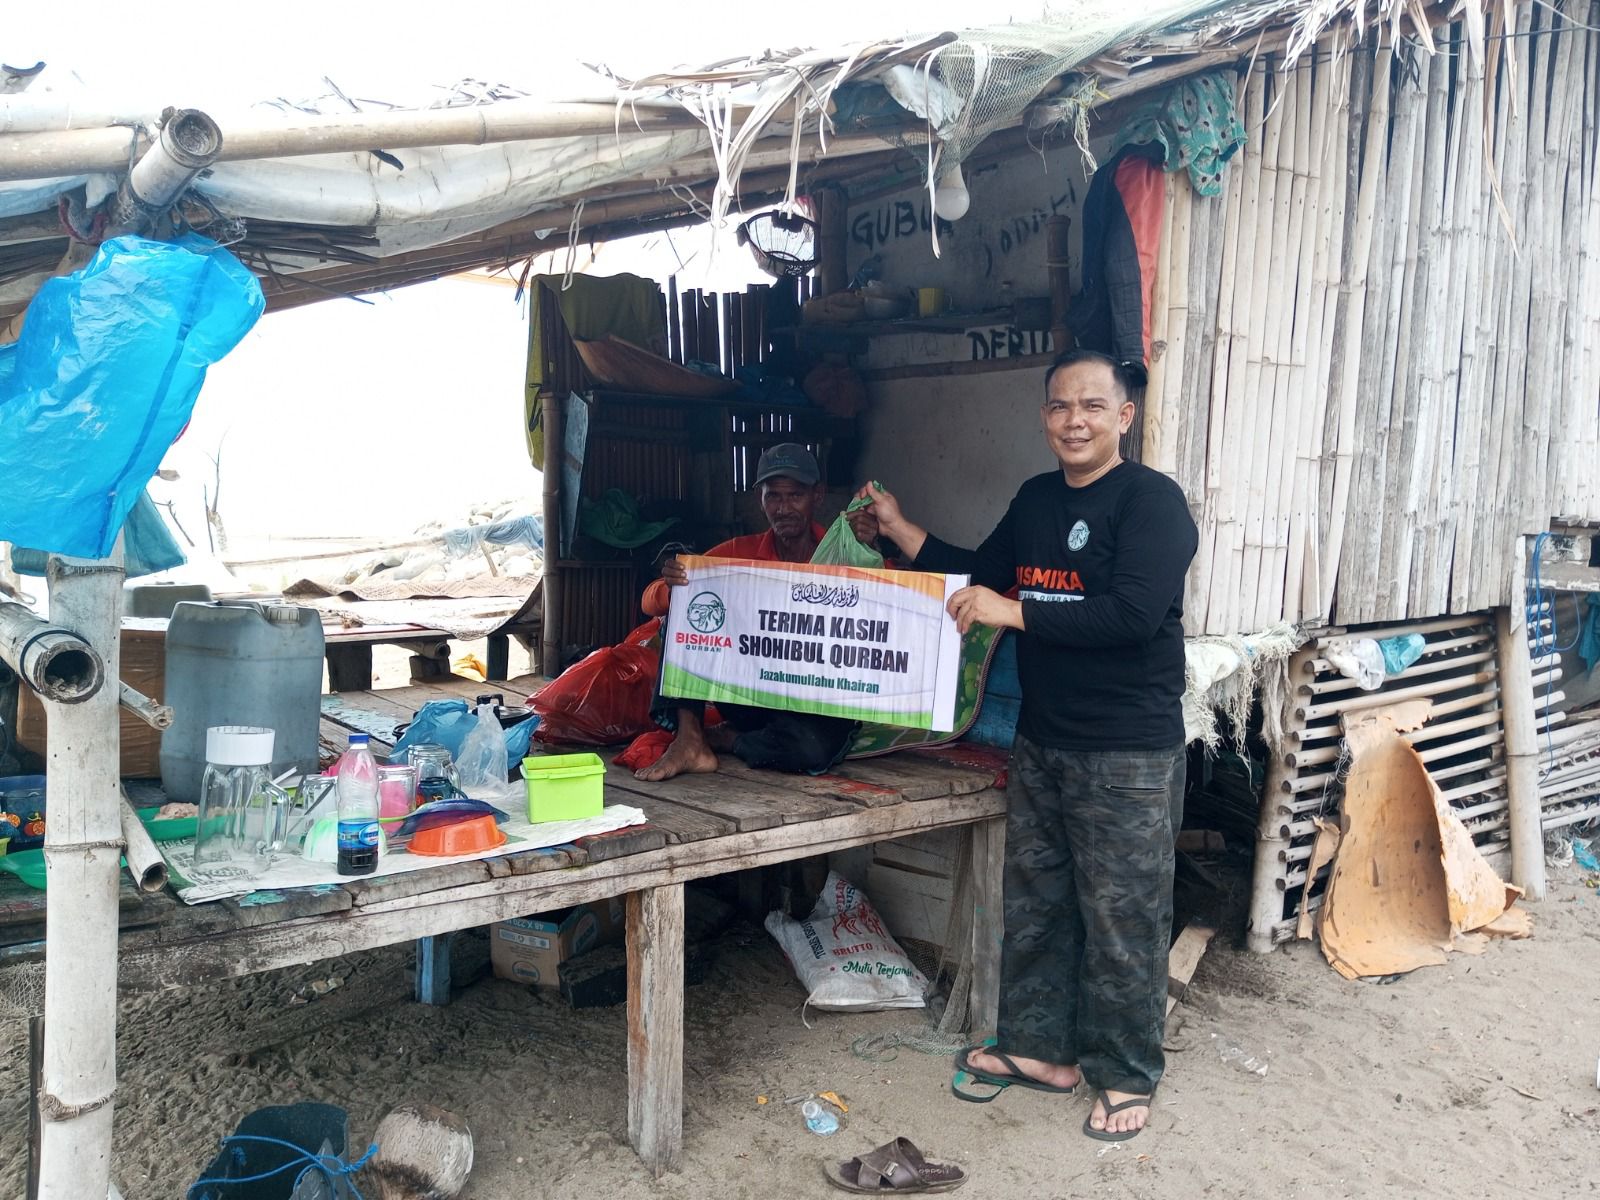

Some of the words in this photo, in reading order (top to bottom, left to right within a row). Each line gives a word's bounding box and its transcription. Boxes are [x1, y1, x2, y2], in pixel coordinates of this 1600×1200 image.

[1017, 566, 1085, 591] ISMIKA
[757, 609, 826, 635] TERIMA
[829, 616, 889, 643] KASIH
[675, 632, 733, 649] BISMIKA
[685, 644, 722, 652] QURBAN
[738, 633, 825, 665] SHOHIBUL
[829, 643, 910, 674] QURBAN
[759, 668, 835, 689] Jazakumullahu
[836, 679, 880, 694] Khairan
[832, 942, 873, 957] BRUTTO
[842, 960, 873, 975] Mutu
